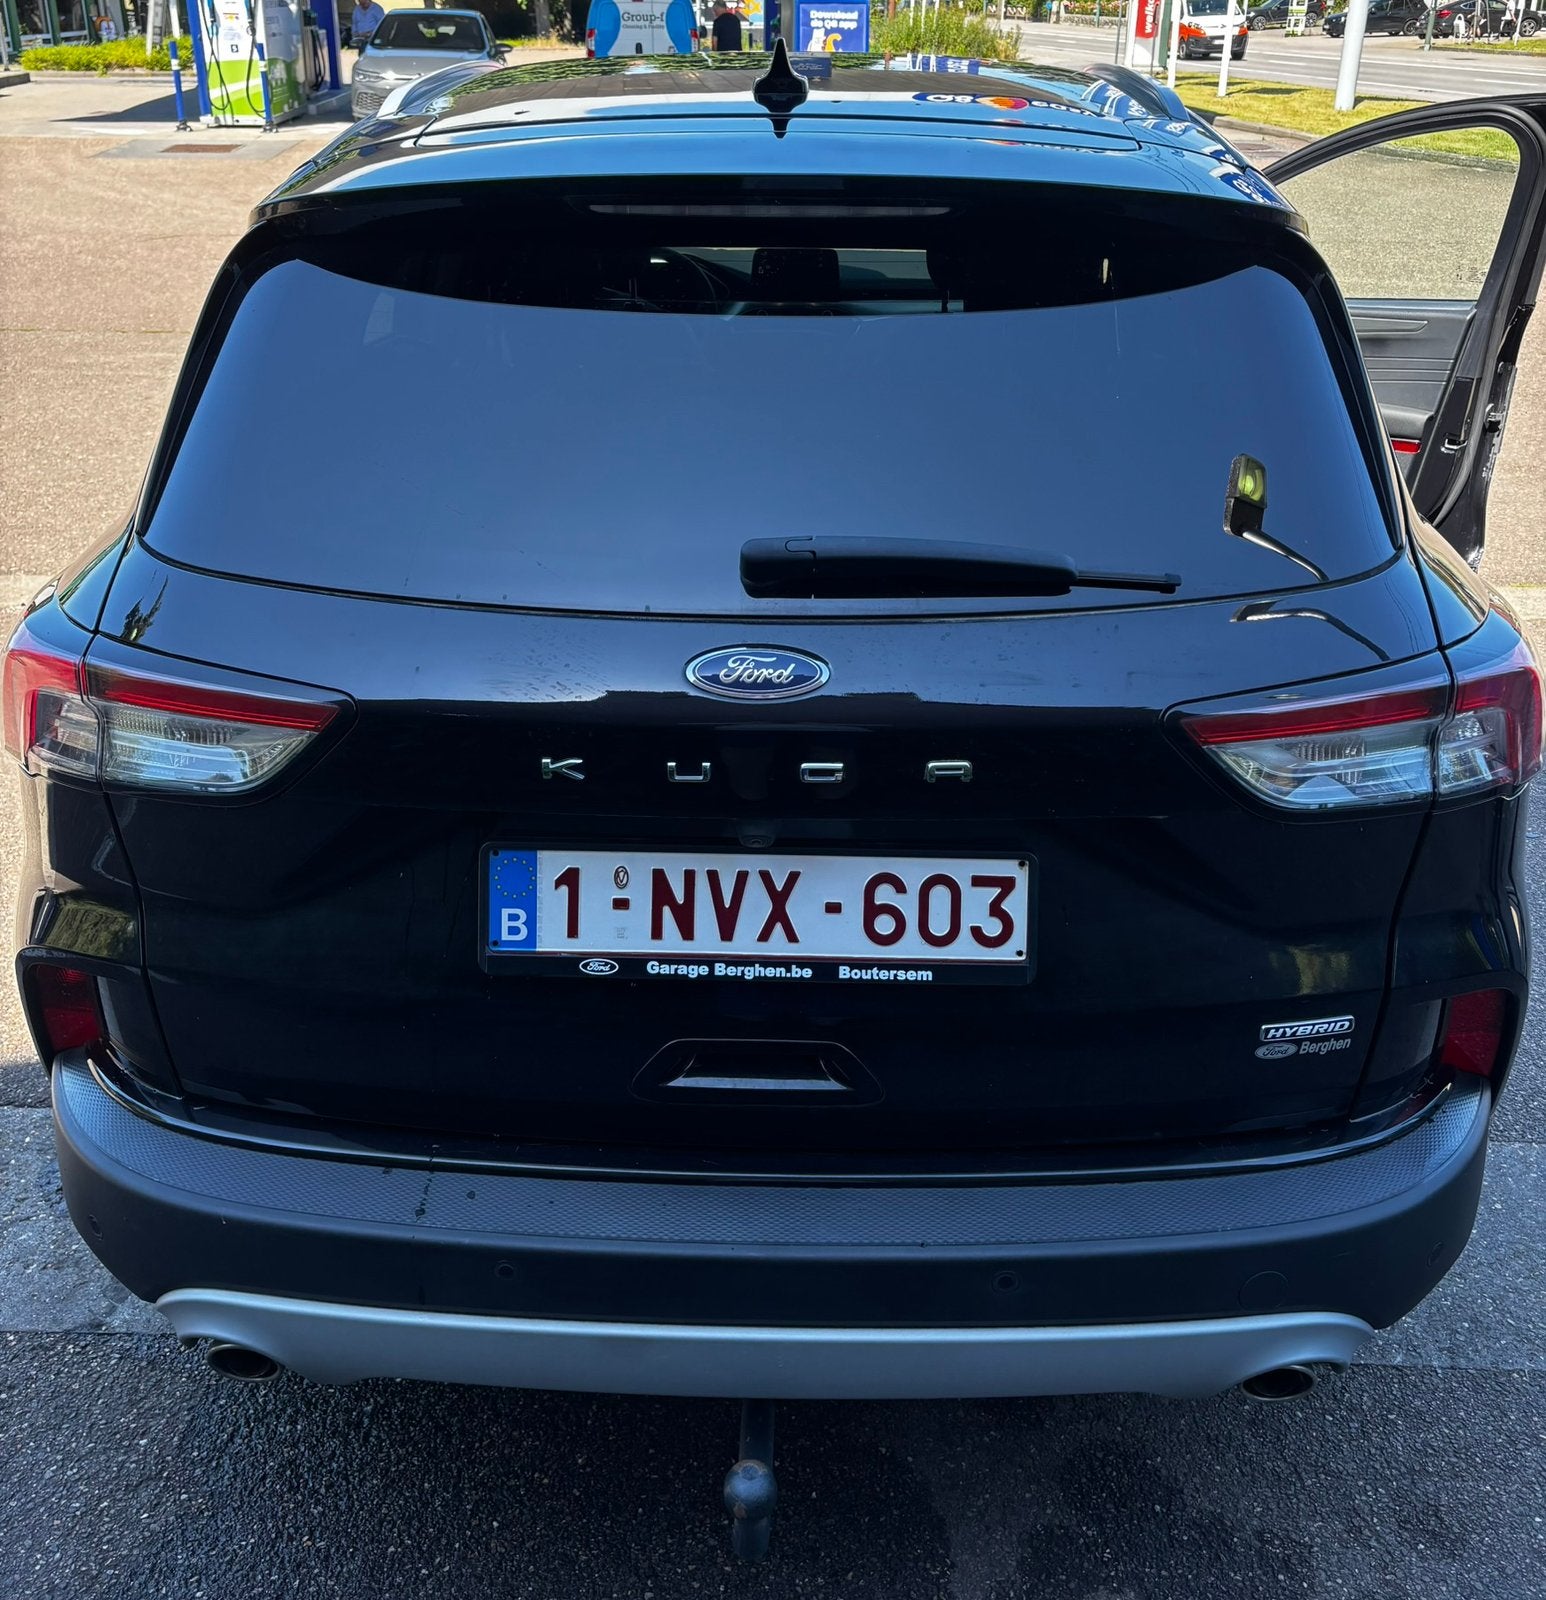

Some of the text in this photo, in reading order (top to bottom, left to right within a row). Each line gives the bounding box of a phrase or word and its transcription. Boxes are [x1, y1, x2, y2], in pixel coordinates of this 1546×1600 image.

[621, 11, 665, 24] Group-f
[718, 654, 795, 685] Ford
[541, 757, 974, 784] KUGA
[501, 908, 529, 941] B
[646, 960, 933, 981] Garage Berghen.be Boutersem
[1266, 1021, 1350, 1039] HYBRID
[1298, 1038, 1352, 1055] Berghen
